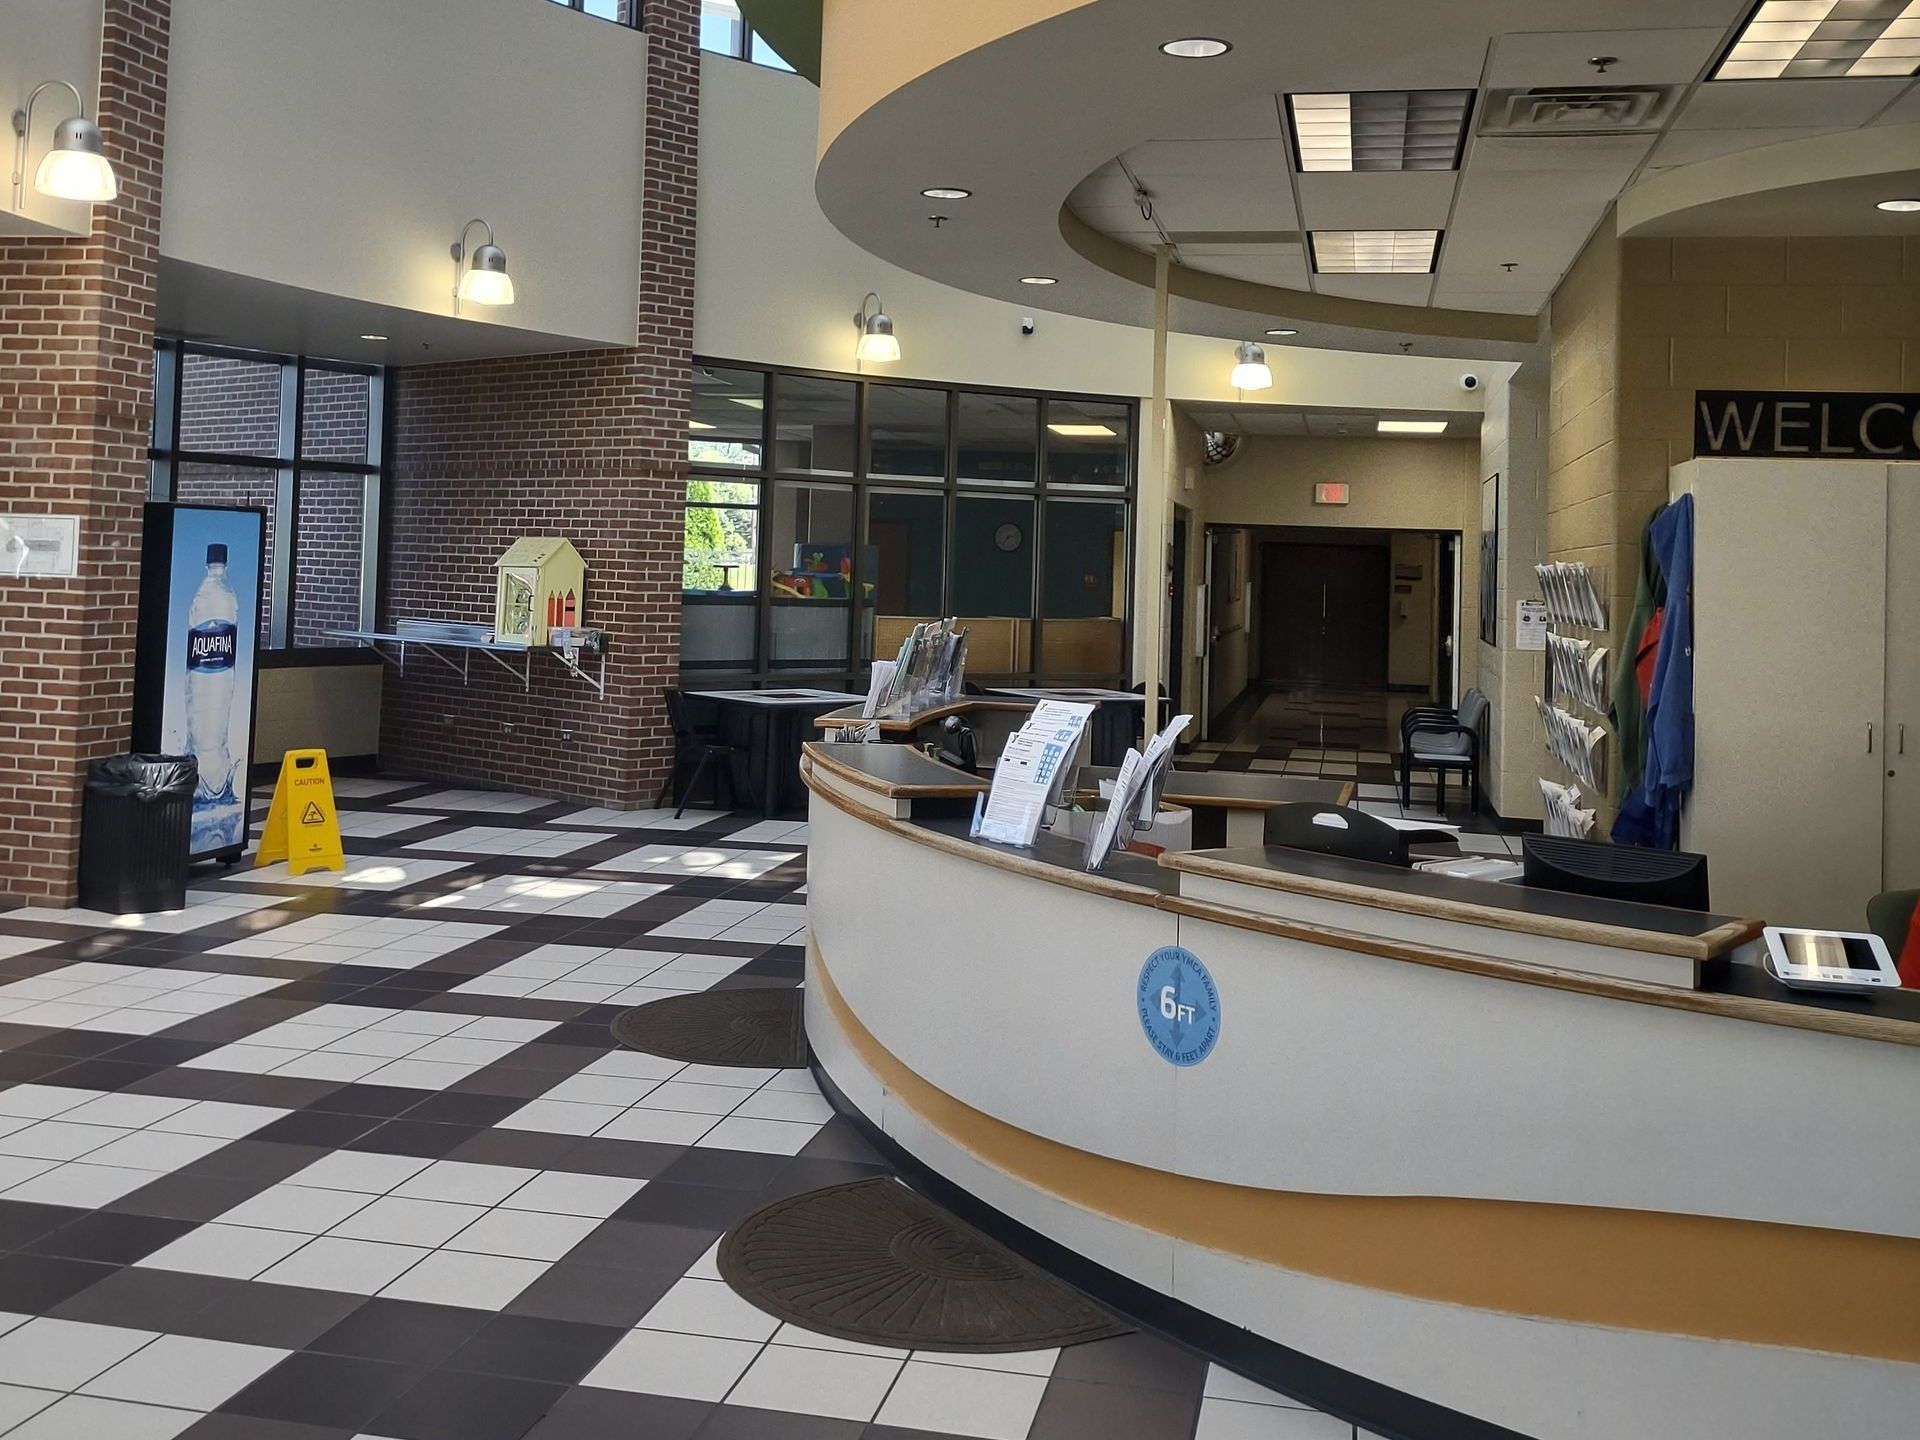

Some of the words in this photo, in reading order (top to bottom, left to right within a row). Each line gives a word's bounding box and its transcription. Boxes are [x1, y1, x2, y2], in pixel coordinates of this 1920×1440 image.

[192, 635, 232, 658] AQUAFINA
[294, 778, 325, 786] CAUTION
[1141, 956, 1159, 992] RESPECT
[1160, 951, 1180, 962] YOUR
[1182, 954, 1202, 977] YMCA
[1201, 973, 1217, 1012] FAMILY
[1160, 985, 1176, 1020] 6
[1177, 1004, 1196, 1025] FT
[1141, 1008, 1157, 1044] PLEASE
[1157, 1040, 1174, 1060] STAY
[1182, 1049, 1199, 1063] FEET
[1199, 1026, 1216, 1056] APART
